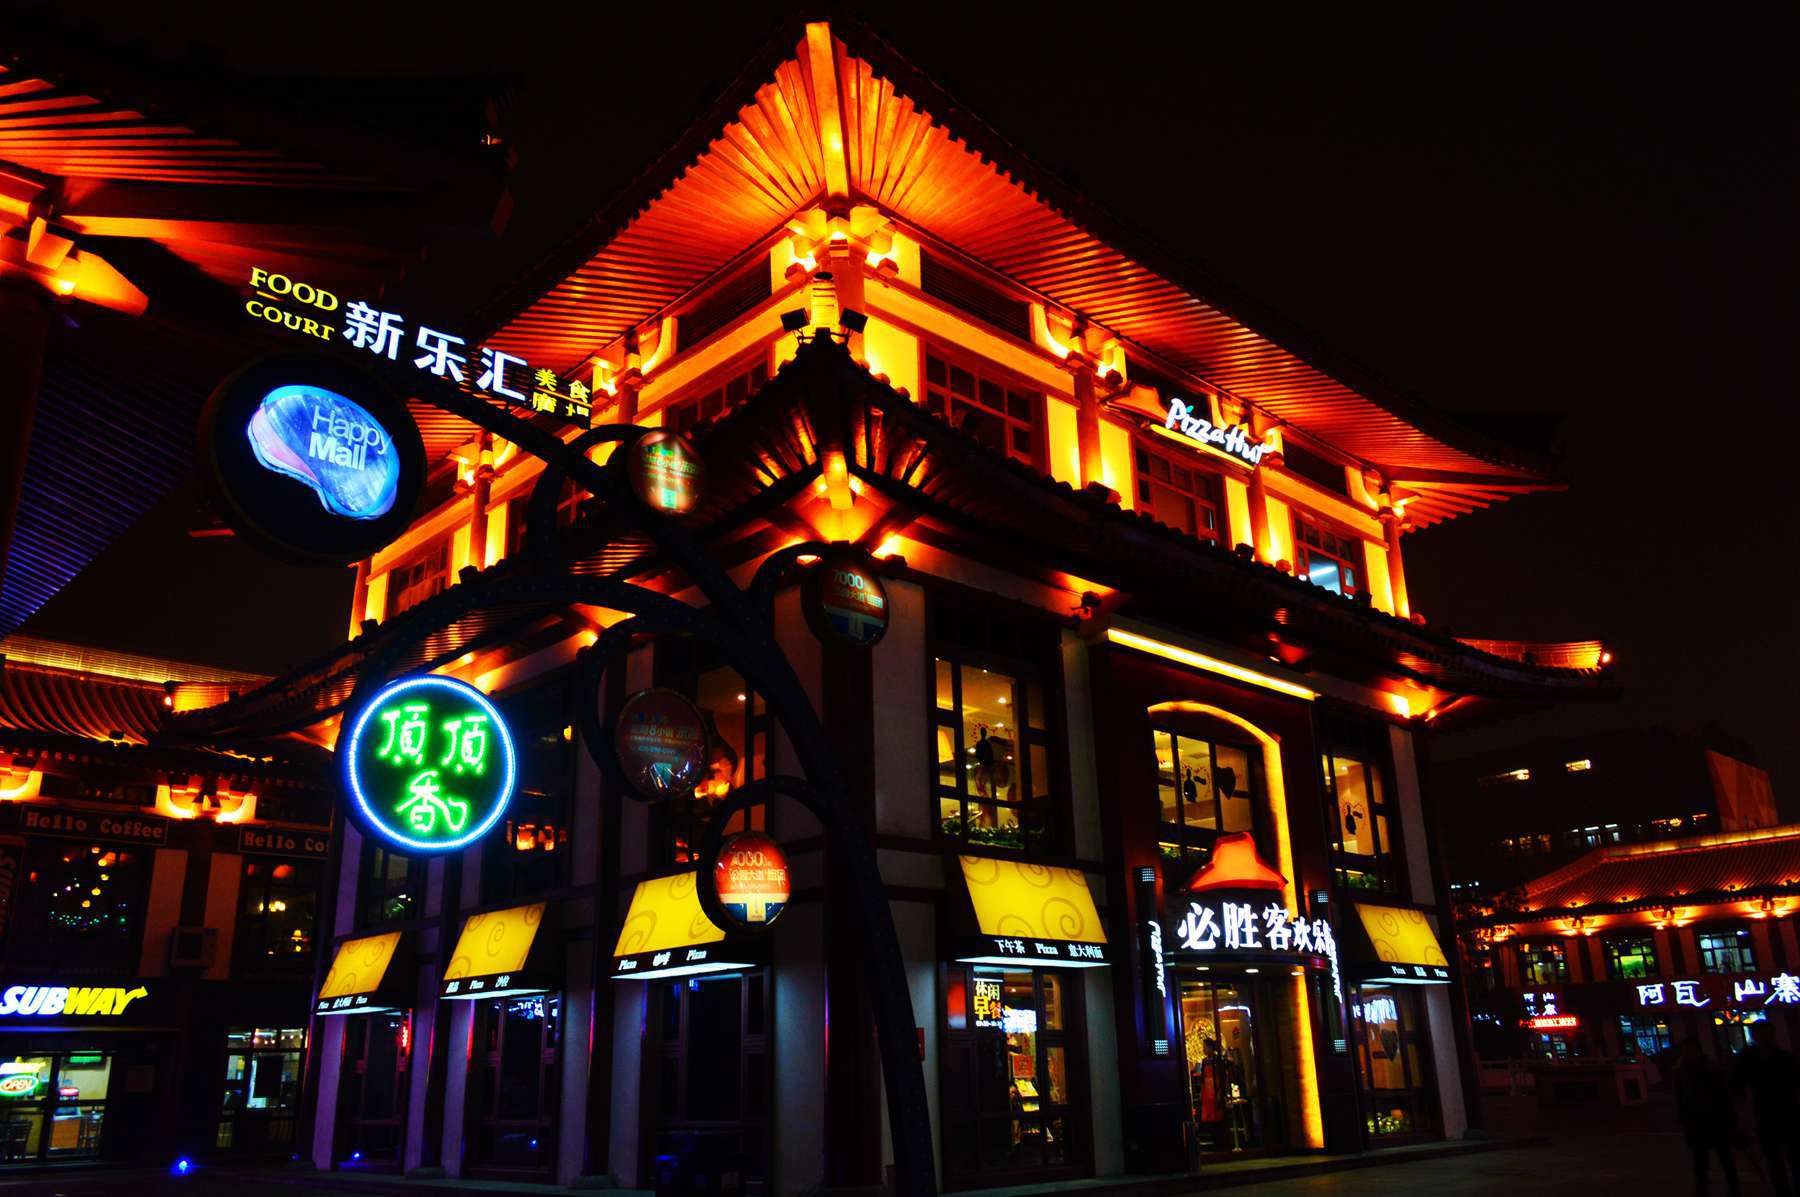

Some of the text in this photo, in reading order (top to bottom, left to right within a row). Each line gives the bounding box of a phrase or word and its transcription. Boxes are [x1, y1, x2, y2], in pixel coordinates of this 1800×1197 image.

[249, 267, 339, 311] FOOD
[246, 300, 335, 341] COURT
[342, 301, 528, 401] 新乐汇
[312, 405, 392, 455] Happy
[1165, 398, 1277, 464] Pizza Hut
[309, 431, 367, 472] Mall
[25, 810, 163, 840] Hello Coffee
[244, 831, 329, 853] Hello Co
[994, 938, 1026, 954] 下午茶
[0, 985, 149, 1015] SUBWAY
